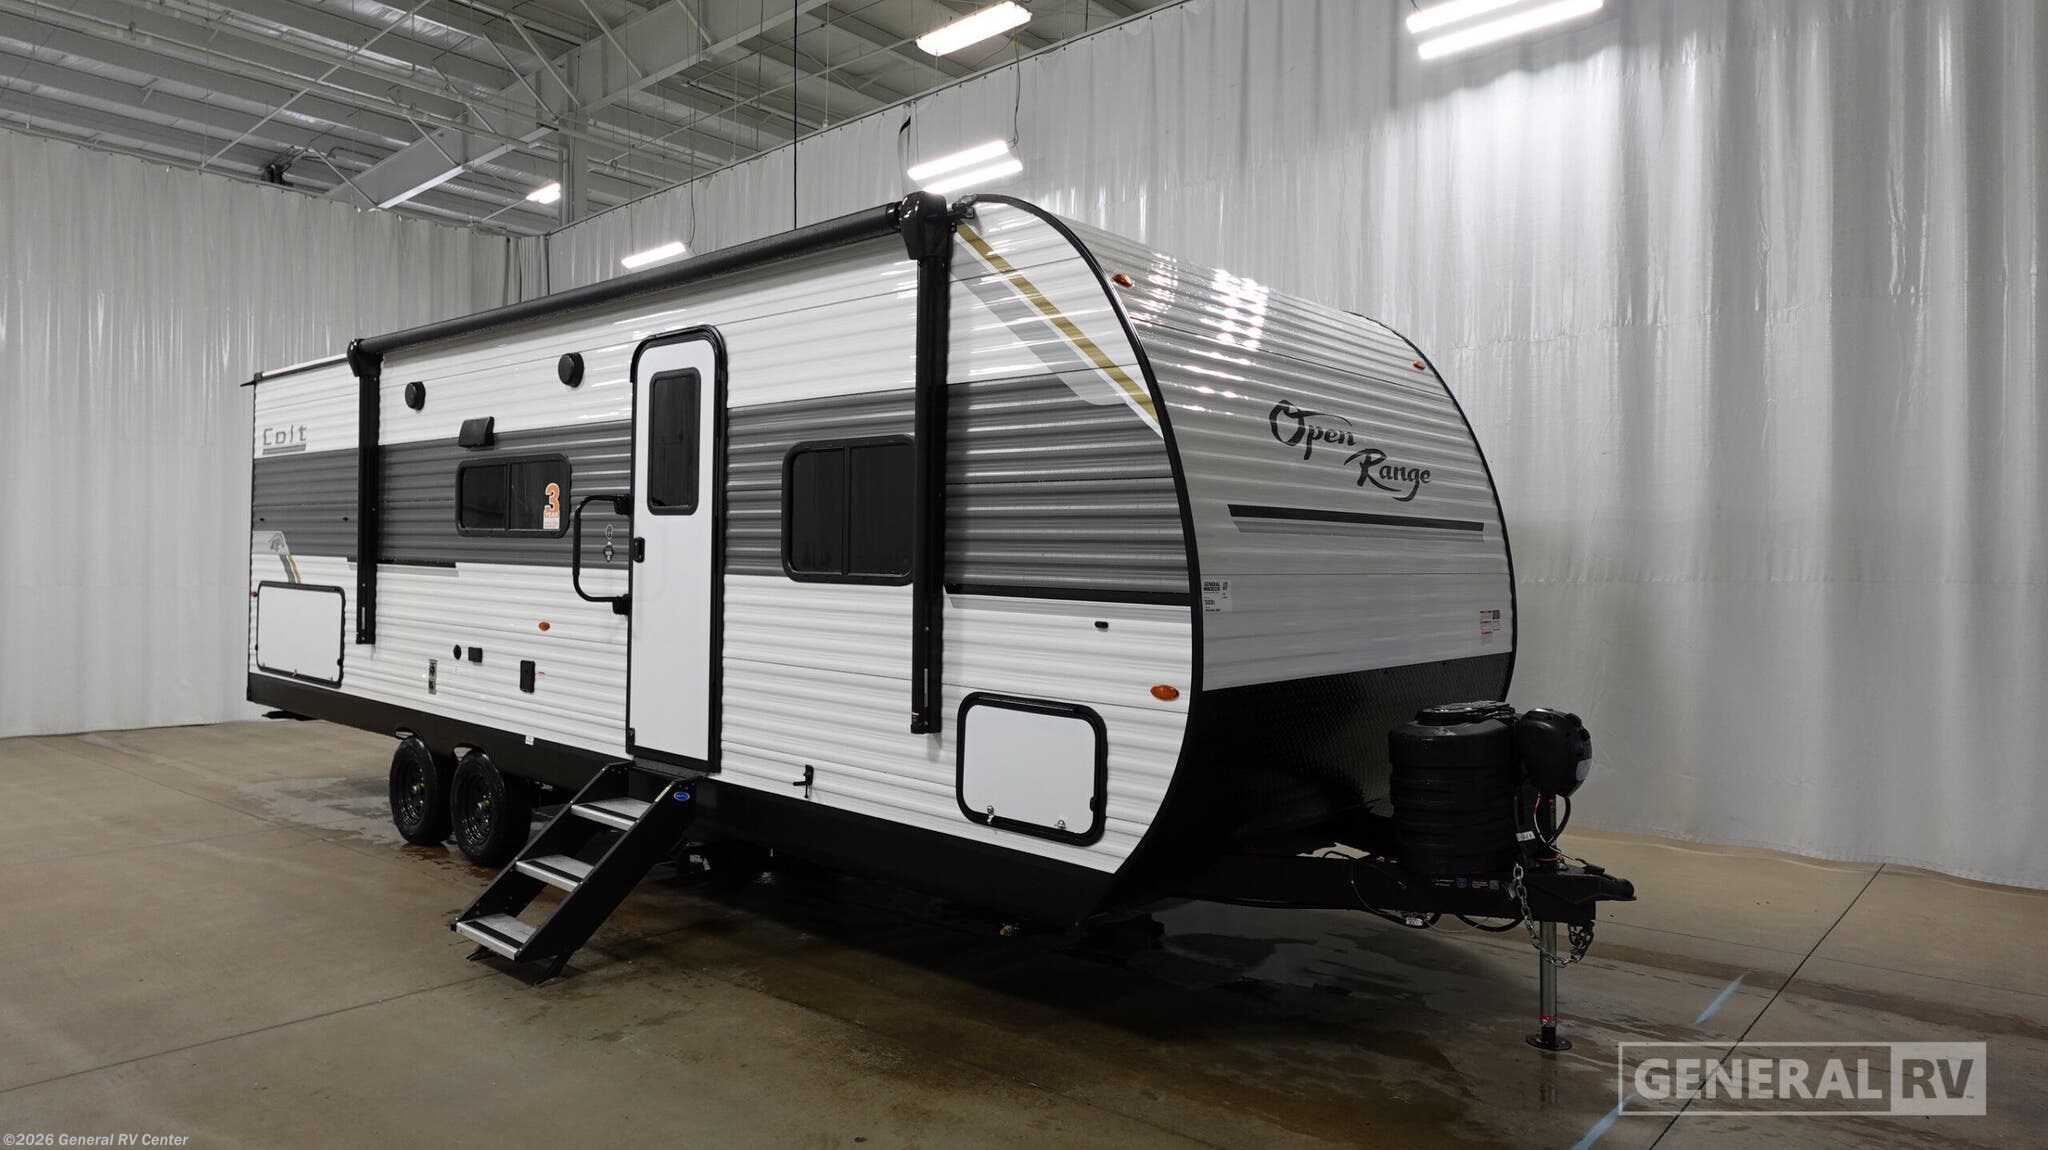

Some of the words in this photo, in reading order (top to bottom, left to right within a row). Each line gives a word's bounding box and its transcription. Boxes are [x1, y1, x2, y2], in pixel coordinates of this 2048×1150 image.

[263, 424, 307, 446] Colt
[1269, 400, 1356, 460] Open
[1344, 448, 1431, 502] Range
[545, 482, 560, 512] 3
